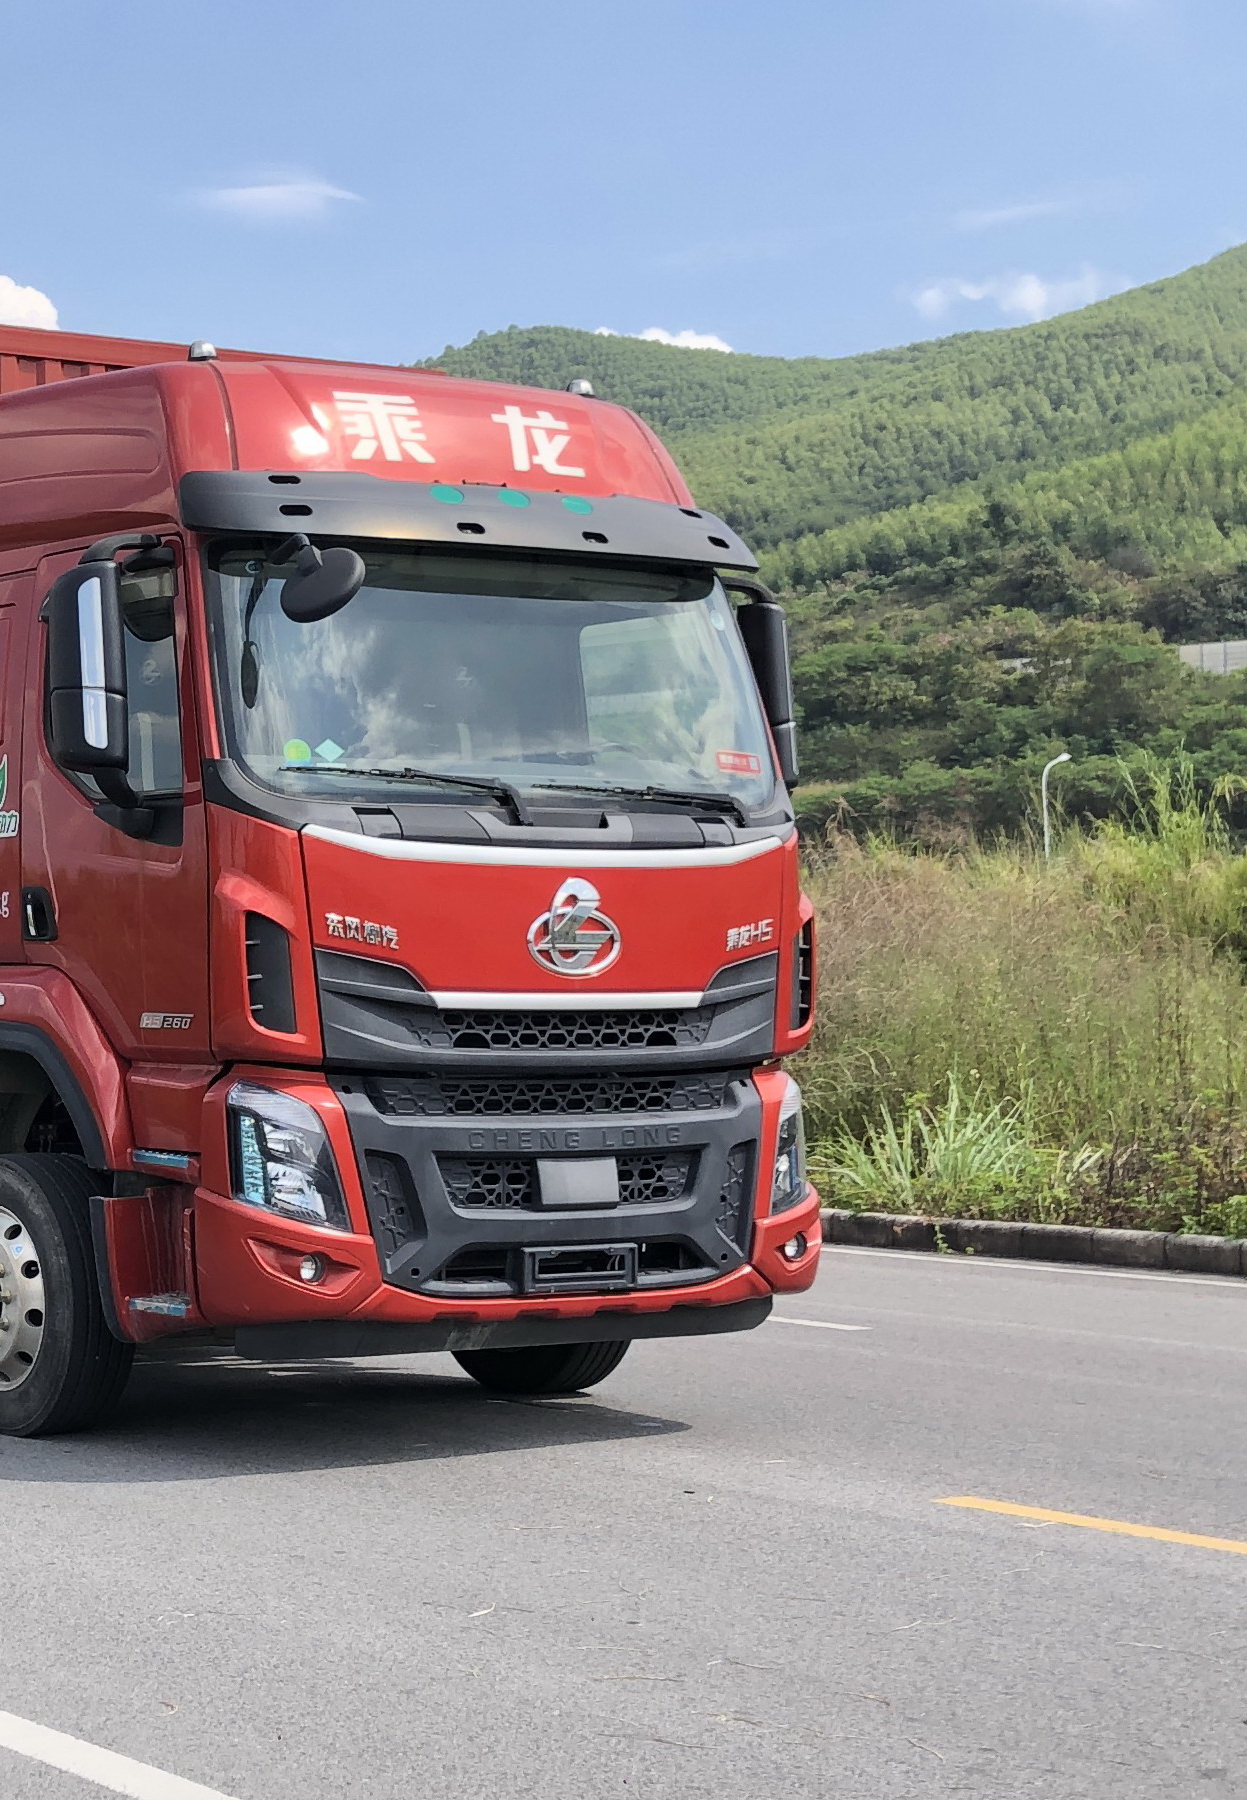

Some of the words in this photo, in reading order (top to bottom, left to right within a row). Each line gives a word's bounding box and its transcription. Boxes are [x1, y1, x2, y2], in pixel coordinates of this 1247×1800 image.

[333, 391, 586, 477] 乘龙
[163, 1017, 191, 1029] 260
[468, 1129, 581, 1150] CHENG
[602, 1125, 682, 1148] LONG
